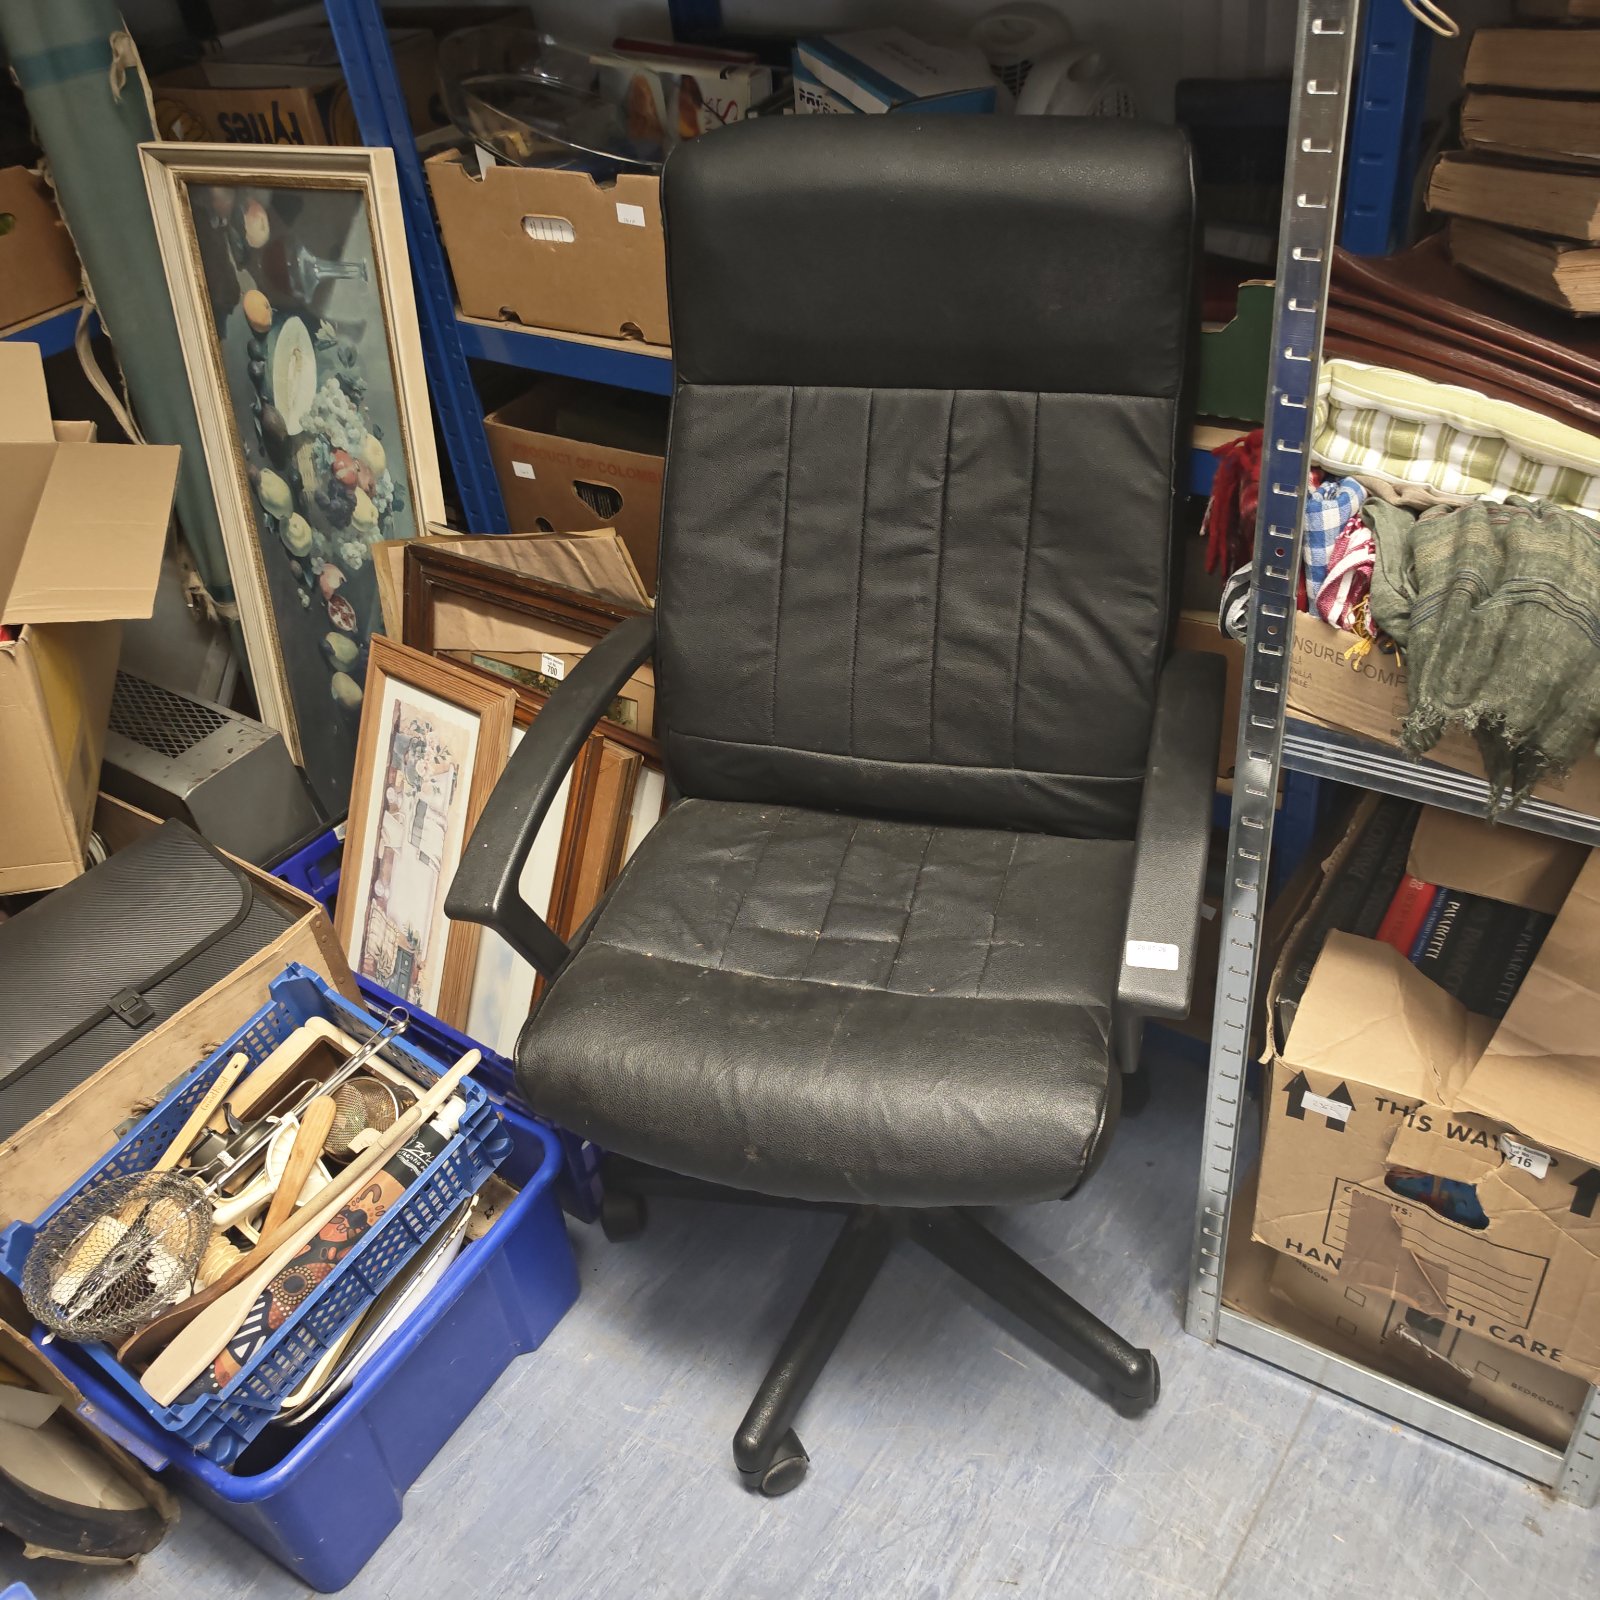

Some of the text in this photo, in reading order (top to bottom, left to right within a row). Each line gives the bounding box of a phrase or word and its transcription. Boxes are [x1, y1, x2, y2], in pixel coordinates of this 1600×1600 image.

[512, 443, 572, 467] PRODUCT
[576, 457, 593, 471] OF
[547, 665, 558, 676] 700
[1293, 635, 1408, 689] NSURE COMP
[1425, 901, 1460, 960] PAVAROTTI
[1374, 1097, 1432, 1133] THIS
[1506, 1152, 1534, 1168] 716
[1285, 1238, 1563, 1363] HAN CARE
